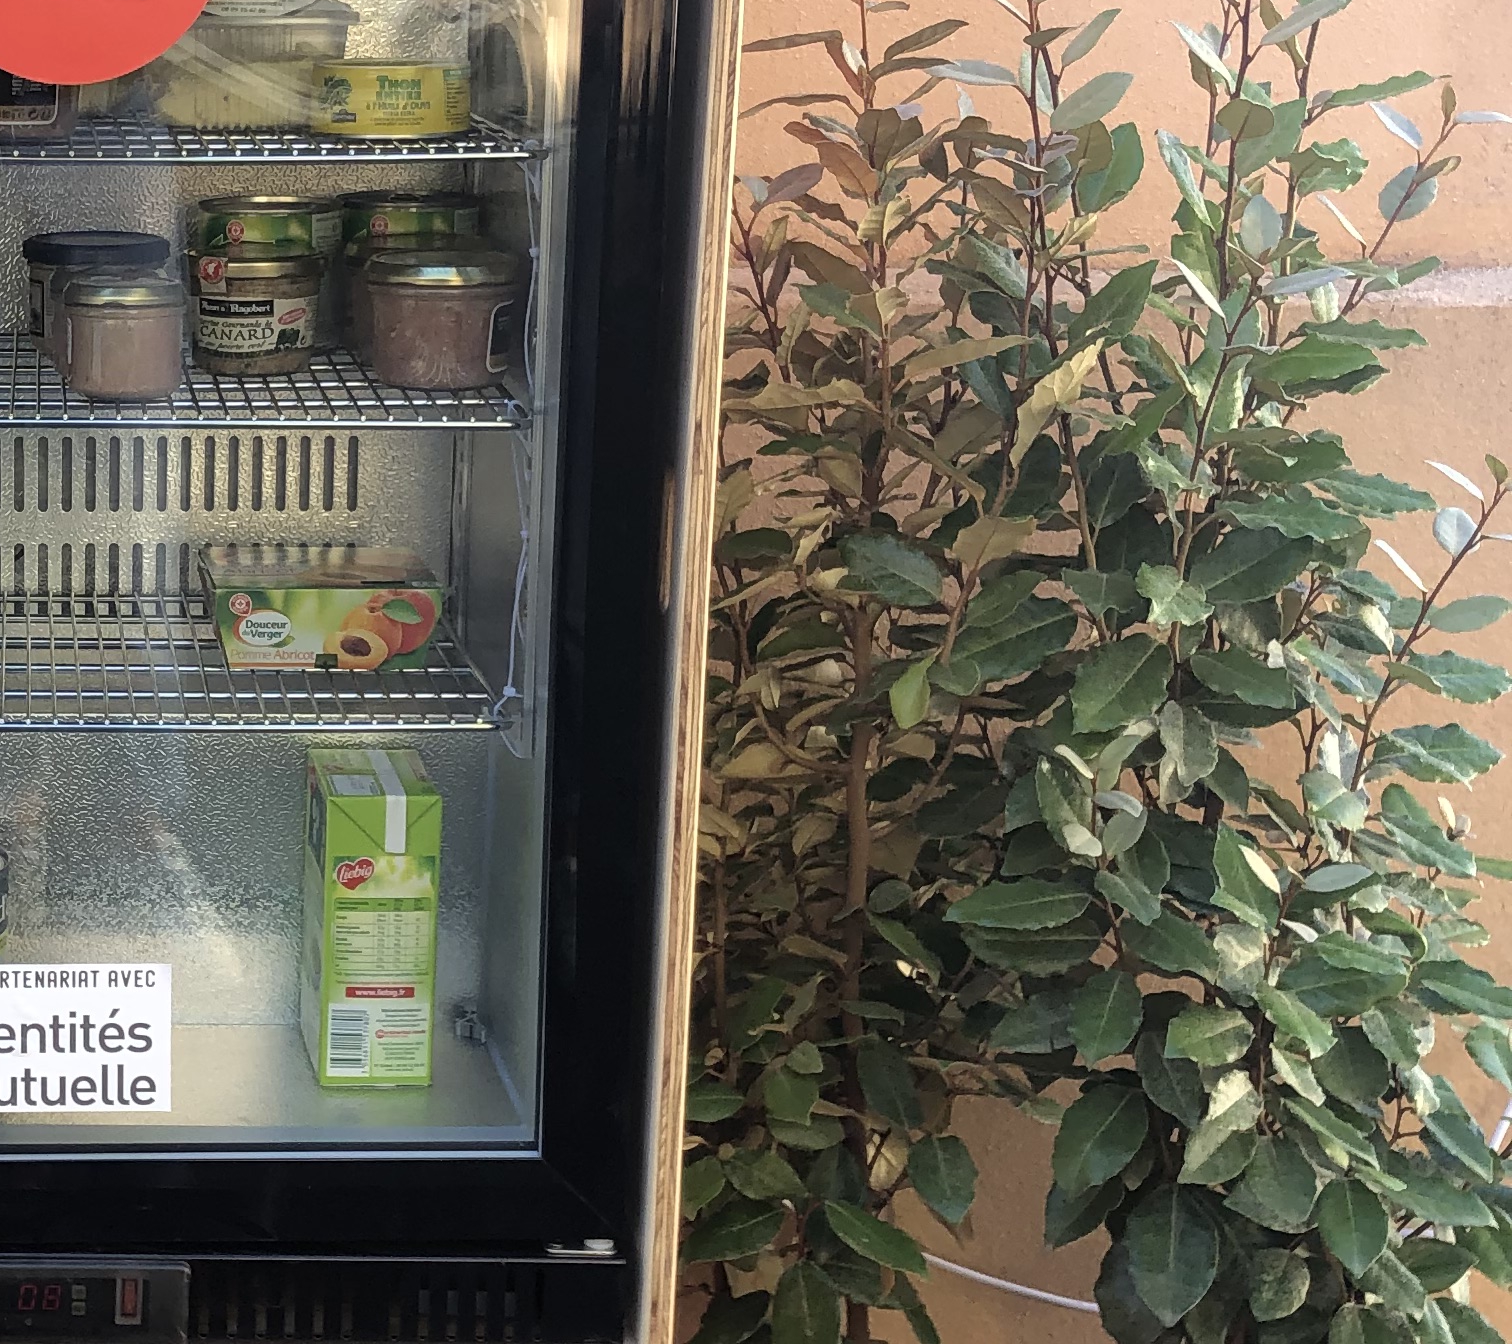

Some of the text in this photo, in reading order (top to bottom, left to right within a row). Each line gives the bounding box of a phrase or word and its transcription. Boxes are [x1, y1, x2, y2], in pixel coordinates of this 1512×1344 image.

[200, 325, 275, 342] CANARD
[245, 619, 288, 629] Douceur
[250, 630, 284, 641] Verger
[230, 649, 315, 661] Pomme Abricot
[339, 865, 373, 883] Liebig
[108, 969, 157, 988] AVEC
